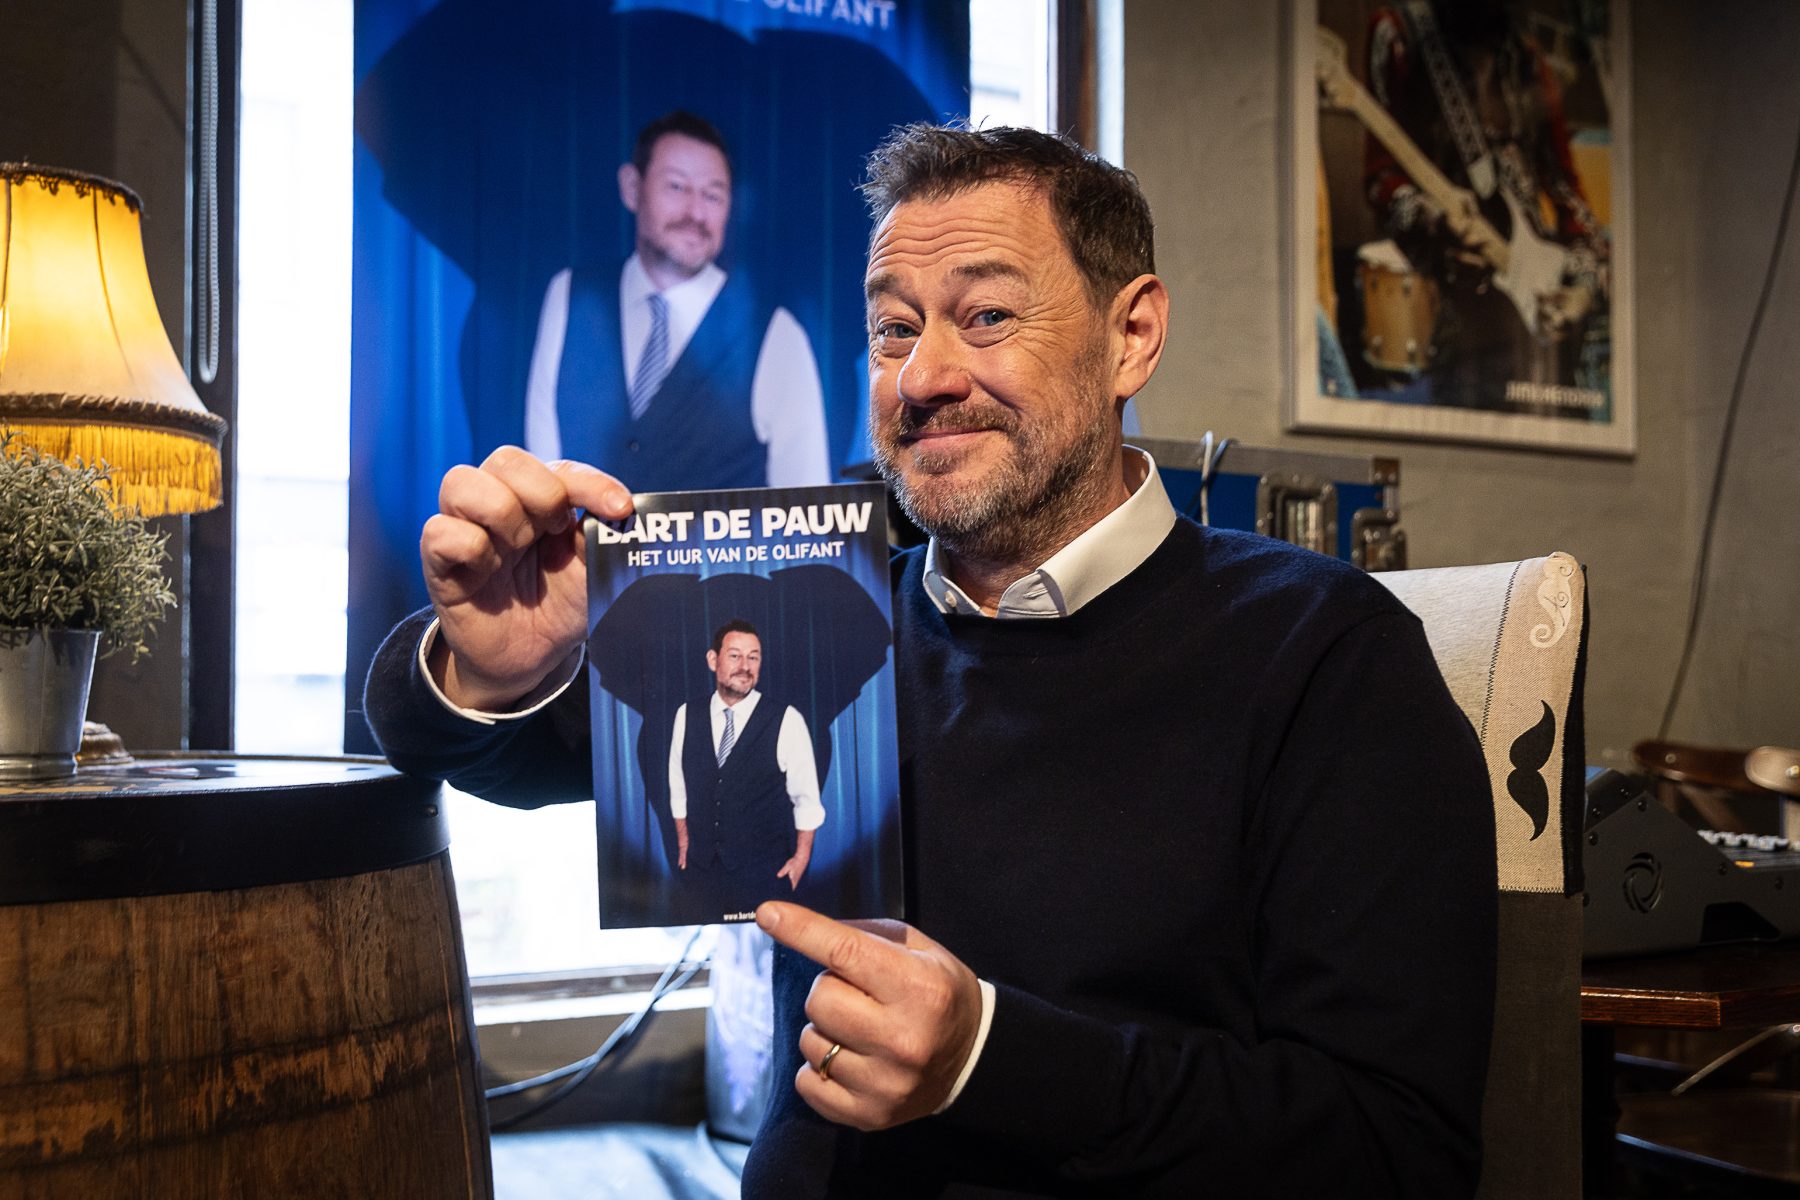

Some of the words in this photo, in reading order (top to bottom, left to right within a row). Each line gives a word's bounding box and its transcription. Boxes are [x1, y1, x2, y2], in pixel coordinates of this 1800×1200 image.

[703, 508, 752, 541] DE
[761, 502, 873, 538] PAUW
[627, 549, 663, 567] HET
[666, 548, 703, 566] UUR
[706, 546, 741, 564] VAN
[745, 544, 769, 562] DE
[772, 540, 845, 561] OLIFANT
